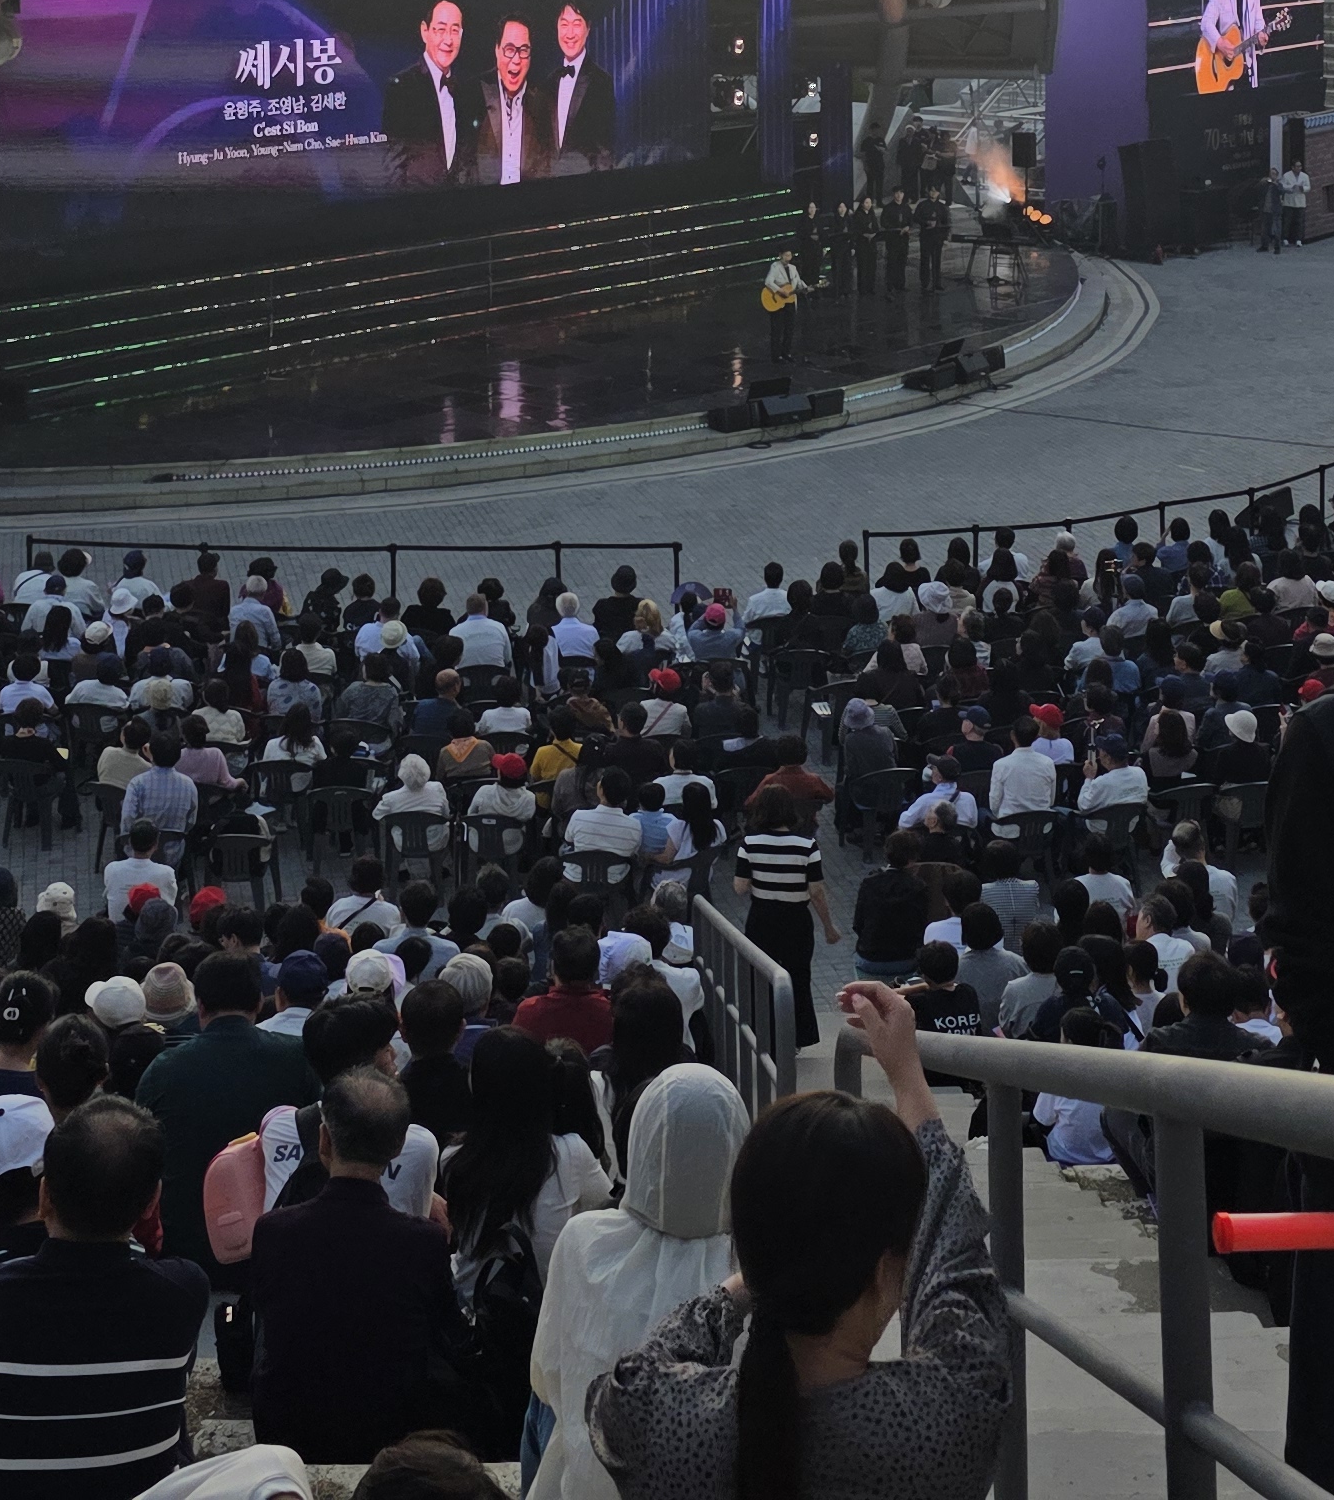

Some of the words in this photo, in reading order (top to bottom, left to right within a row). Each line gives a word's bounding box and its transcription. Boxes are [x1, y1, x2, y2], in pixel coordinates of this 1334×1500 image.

[223, 100, 264, 121] 윤형주,
[282, 120, 294, 134] Si
[297, 120, 319, 133] Bon
[178, 149, 224, 166] Hyung-Ju
[370, 131, 388, 144] Kim
